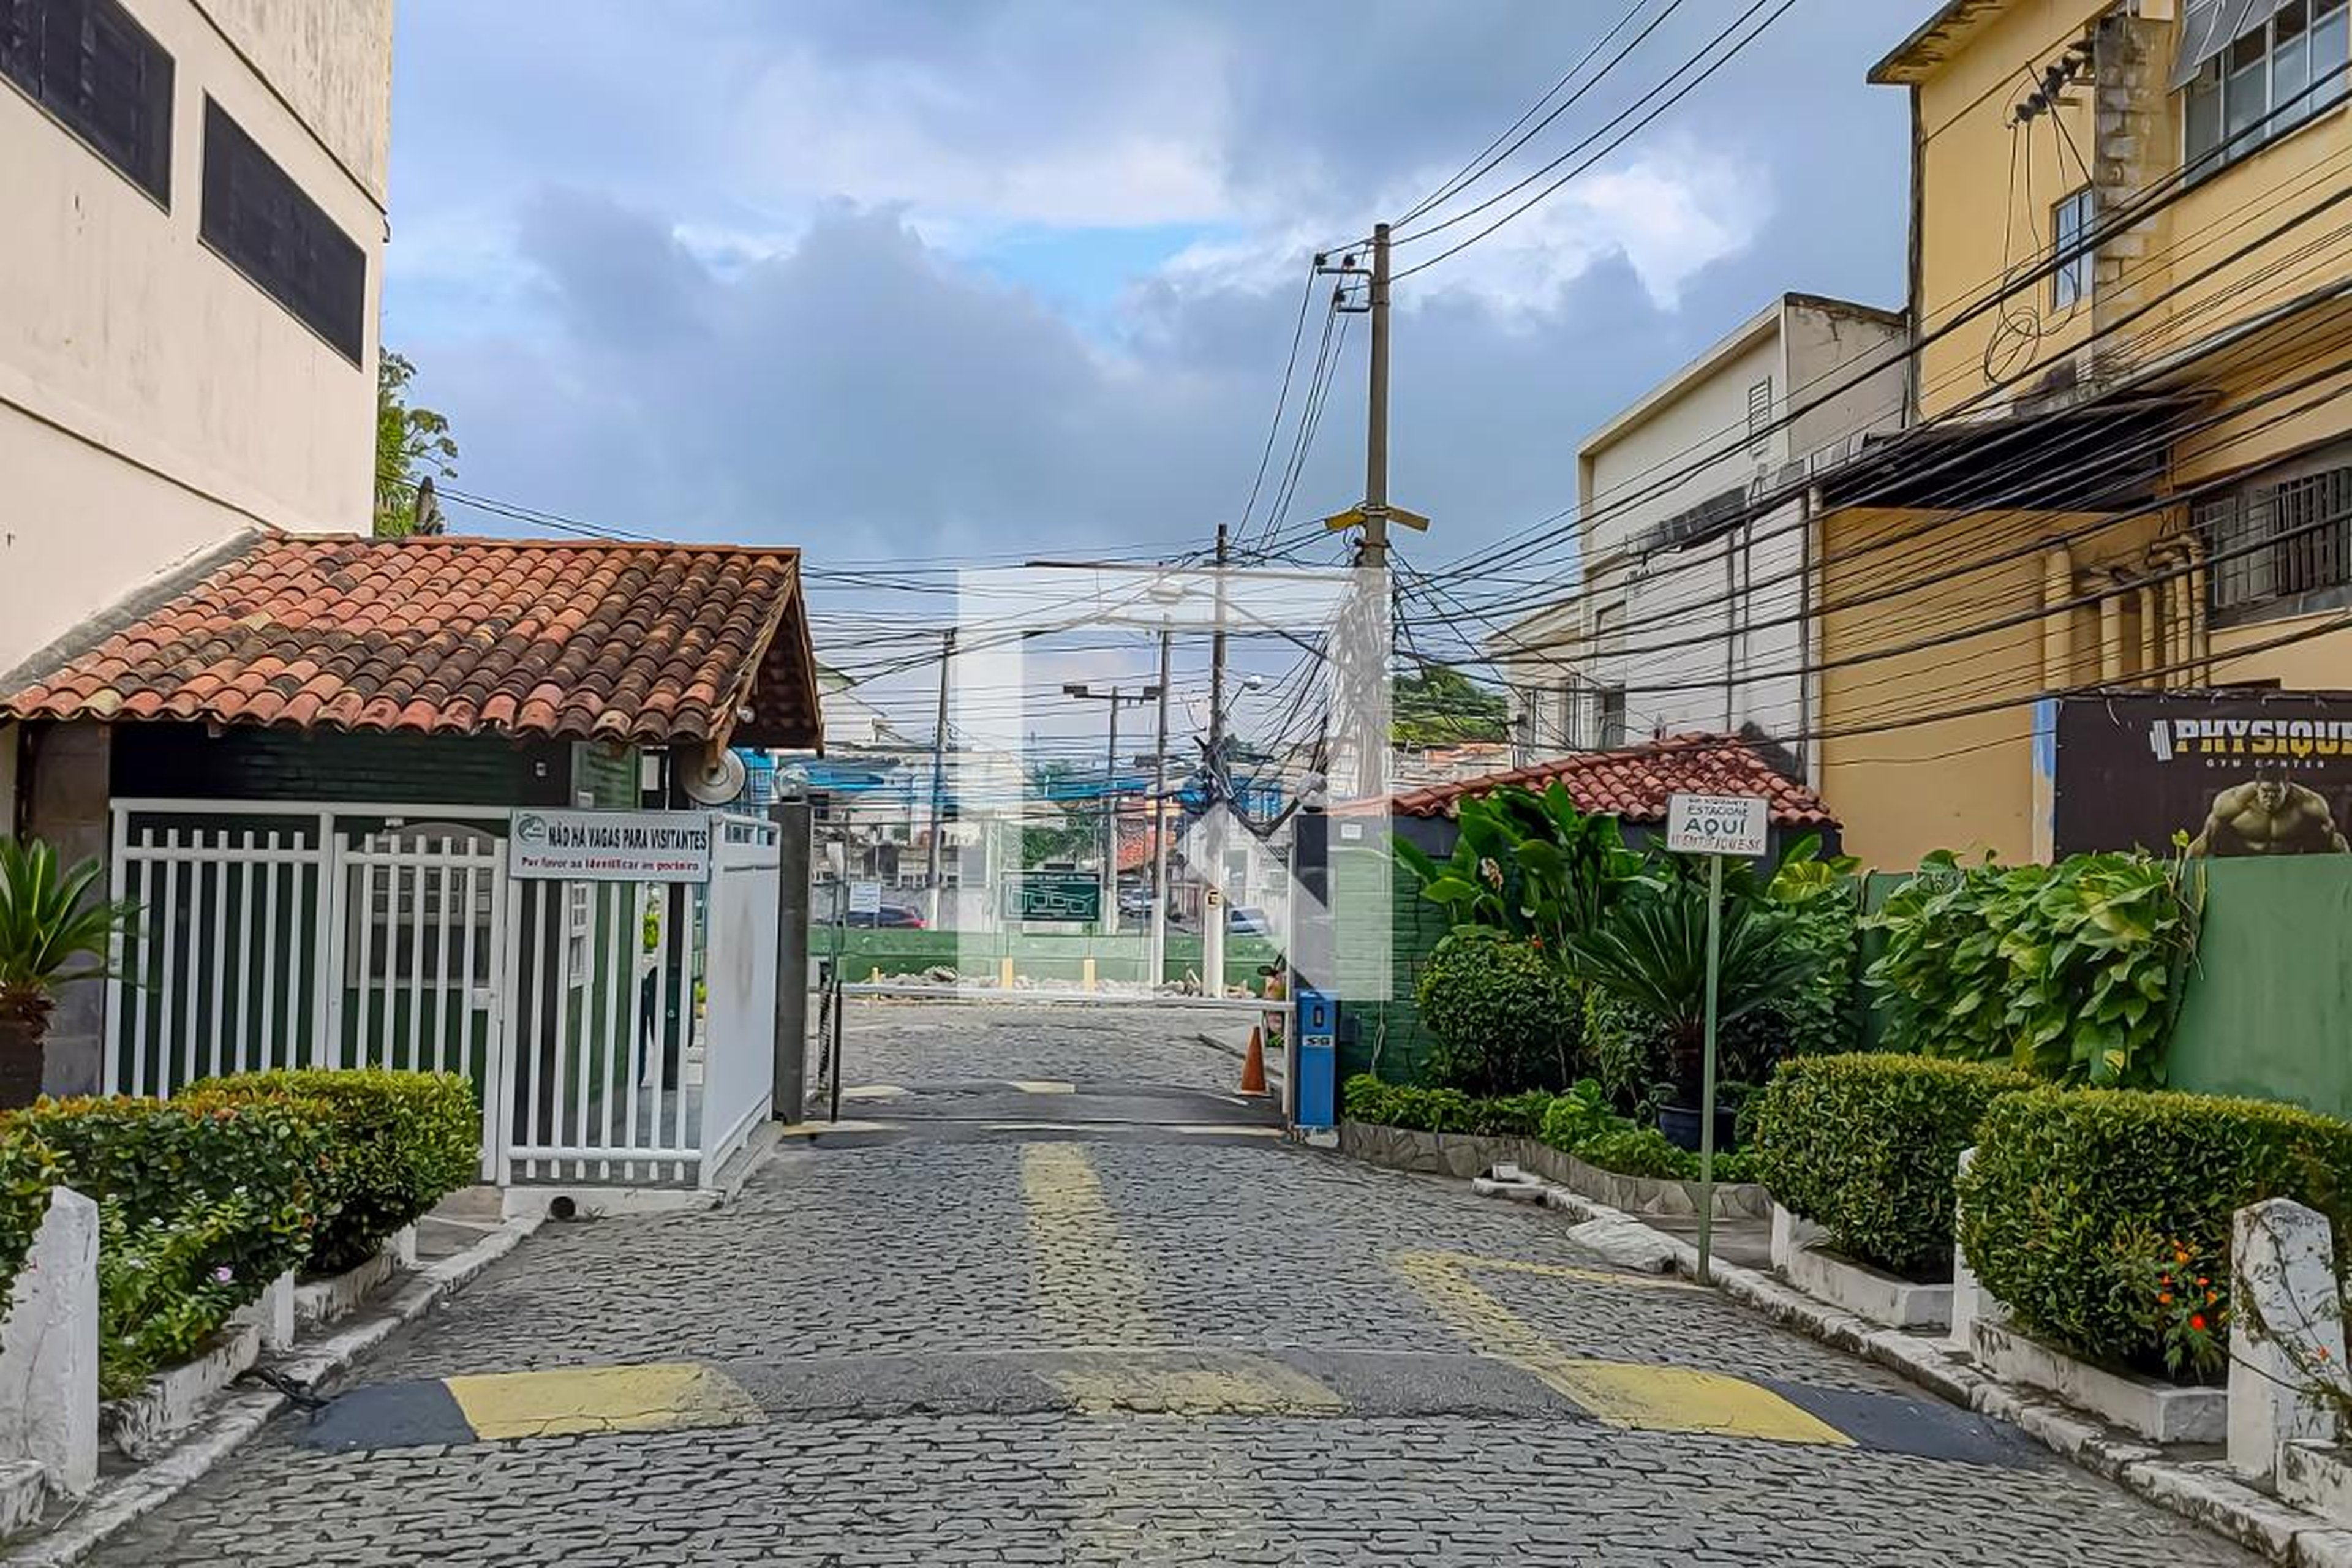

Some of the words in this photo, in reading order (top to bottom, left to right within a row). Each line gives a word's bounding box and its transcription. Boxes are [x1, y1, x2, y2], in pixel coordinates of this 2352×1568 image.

[2206, 759, 2241, 768] GYM
[1687, 805, 1749, 816] ESTACIONE
[1684, 818, 1746, 836] AQUI
[588, 827, 620, 849] VAGAS
[623, 827, 647, 849] PARA
[650, 828, 707, 850] VISITANTES
